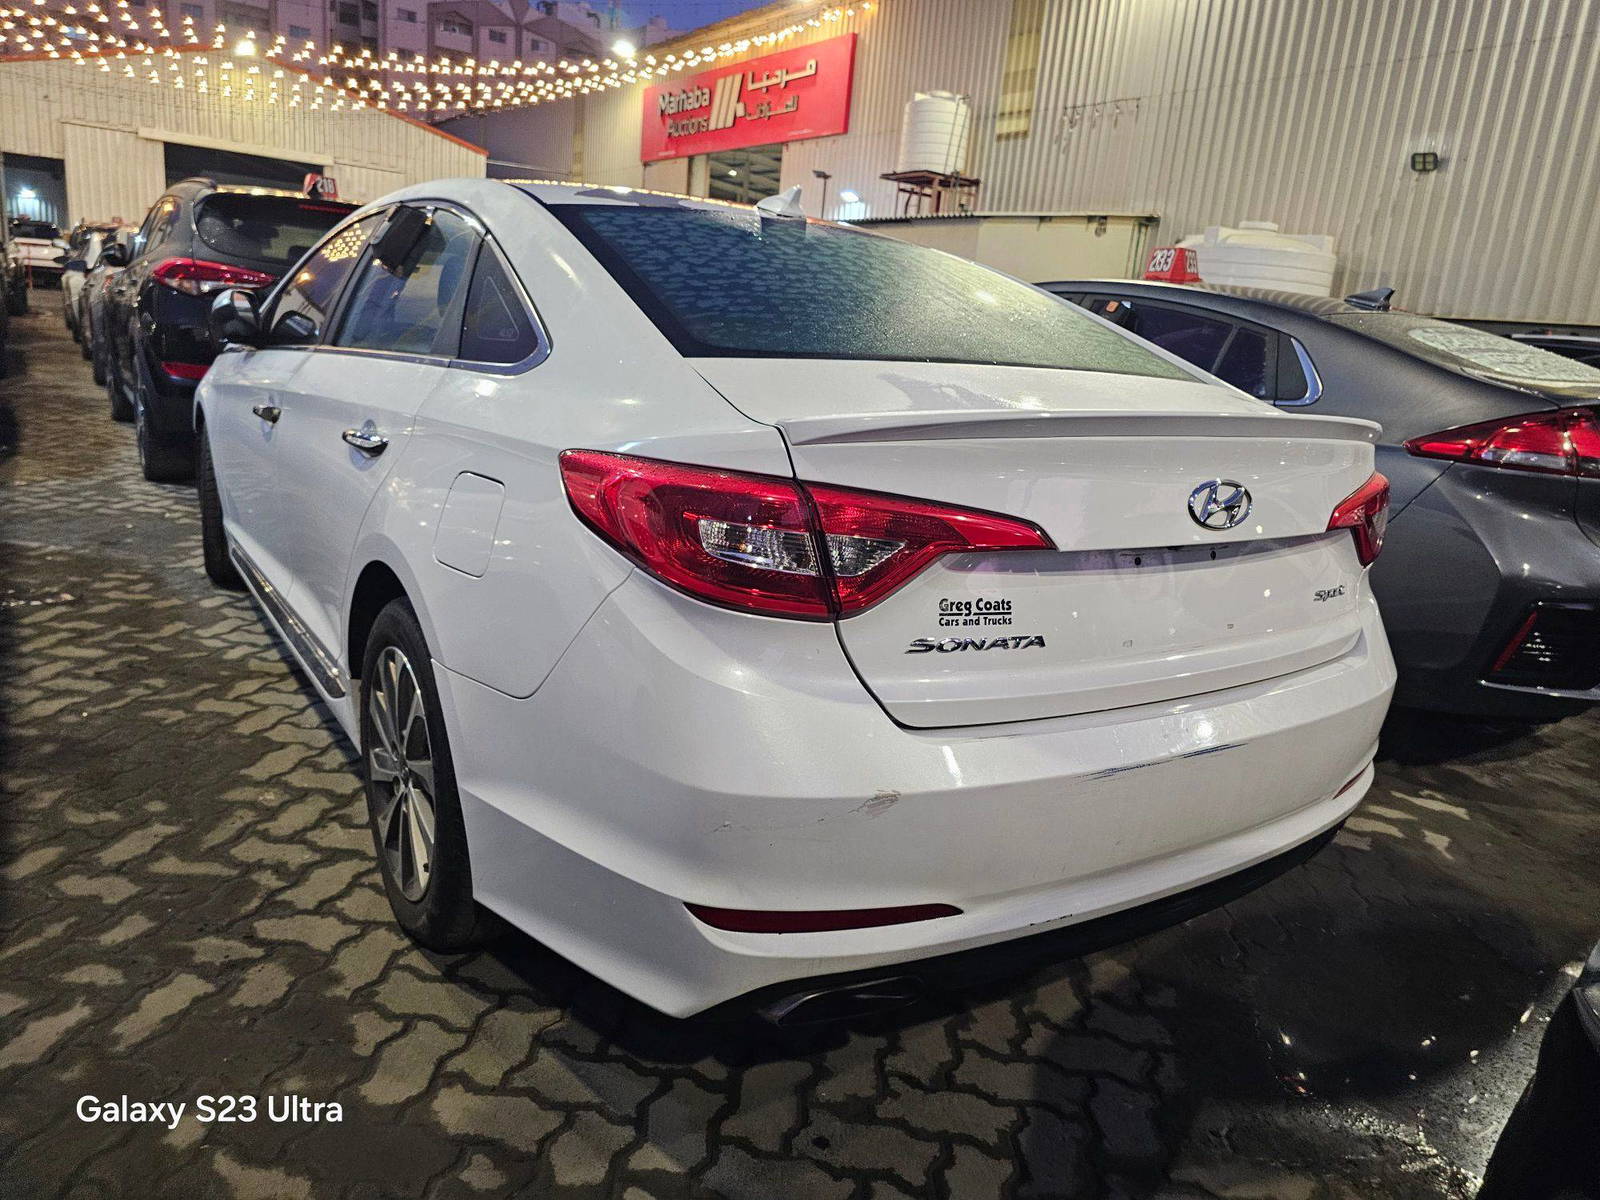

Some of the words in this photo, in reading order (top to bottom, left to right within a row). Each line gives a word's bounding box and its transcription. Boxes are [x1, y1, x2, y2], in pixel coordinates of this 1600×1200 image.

[658, 86, 711, 115] Marhaba
[668, 116, 709, 138] Auctions
[938, 598, 972, 617] Greg
[975, 597, 1012, 612] Coats
[938, 617, 960, 627] Cars
[962, 616, 980, 626] and
[983, 615, 1012, 626] Trucks
[904, 635, 1046, 655] SONATA
